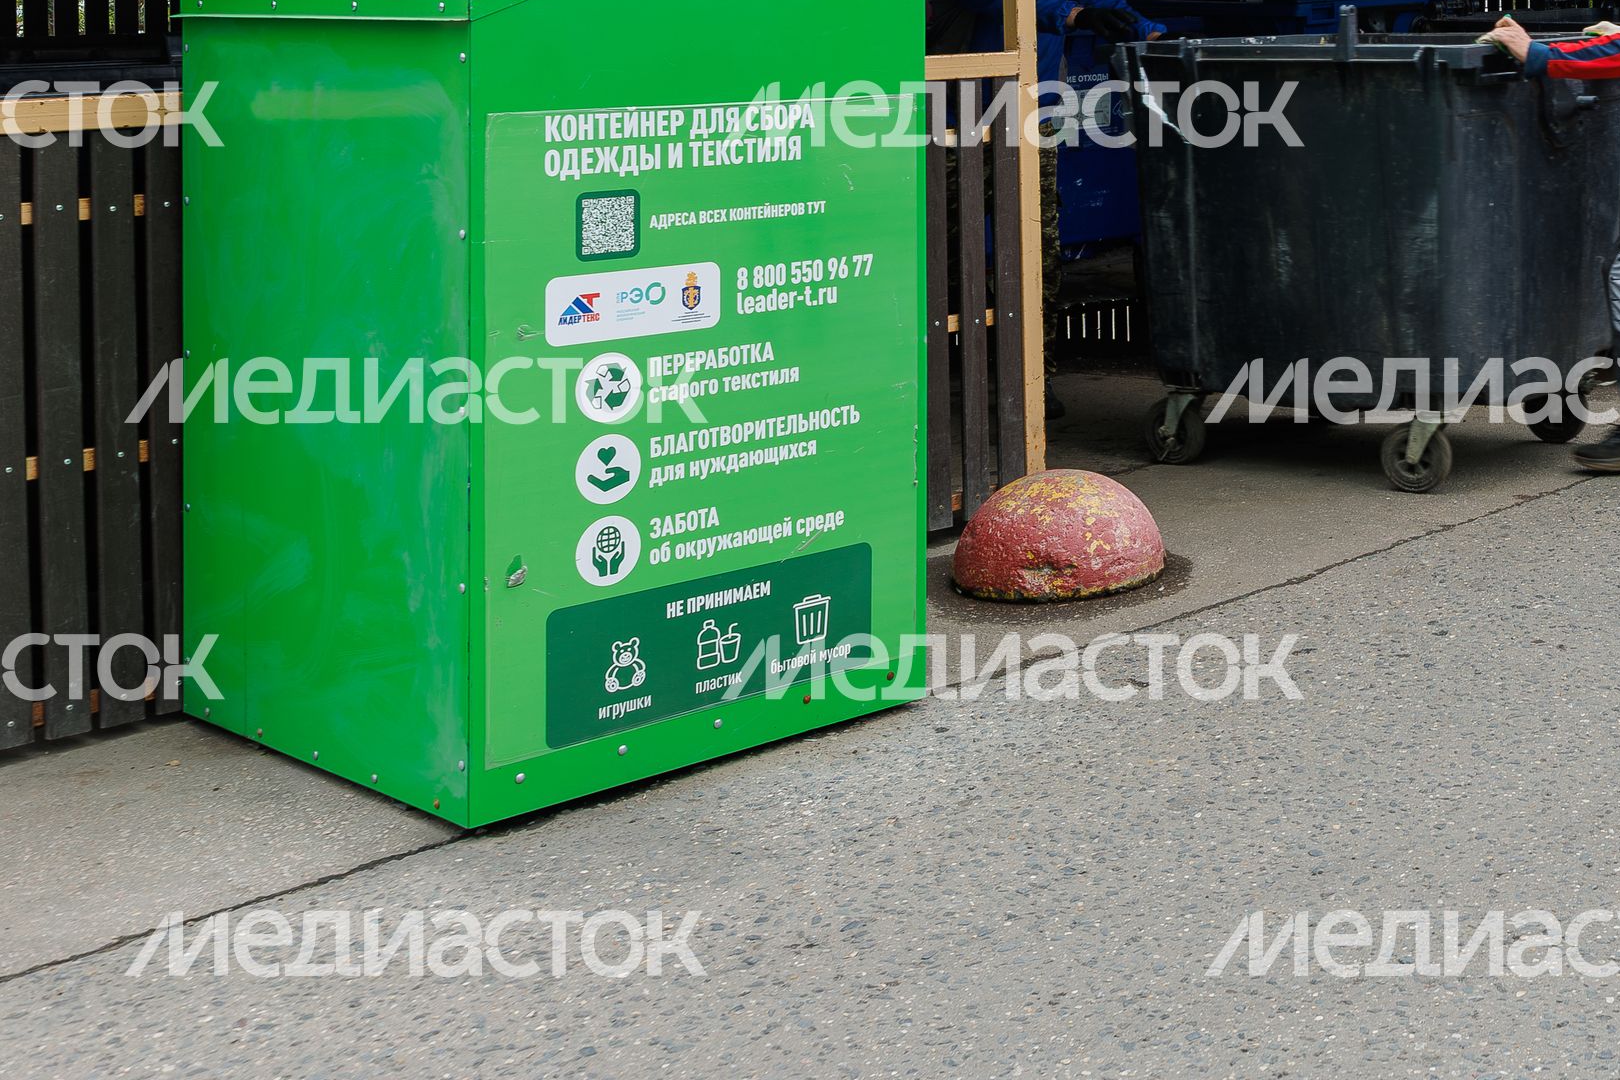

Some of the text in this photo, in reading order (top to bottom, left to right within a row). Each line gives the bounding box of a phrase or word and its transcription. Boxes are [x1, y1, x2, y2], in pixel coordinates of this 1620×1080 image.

[1078, 73, 1109, 83] ОТХОДЫ
[544, 103, 815, 143] КОНТЕЙНЕР ДЛЯ СБОРА
[544, 136, 802, 181] ОДЕЖДЫ И ТЕКСТИЛЯ
[649, 200, 827, 230] АДРЕСА ВСЕХ КОНТЕЙНЕРОВ ТУТ
[736, 253, 874, 291] 8 800 550 96 77
[736, 286, 838, 315] leader-t.ru
[649, 341, 775, 378] ПЕРЕРАБОТКА
[649, 366, 800, 404] старого текстиля
[650, 404, 860, 459] БЛАГОТВОРИТЕЛЬНОСТЬ
[649, 439, 817, 488] для нуждающихся
[649, 506, 720, 539] ЗАБОТА
[649, 510, 845, 565] об окружающей среде
[666, 580, 771, 619] НЕ ПРИНИМАЕМ
[769, 643, 852, 675] бытовой мусор
[695, 670, 743, 695] пластик
[597, 694, 652, 720] игрушки
